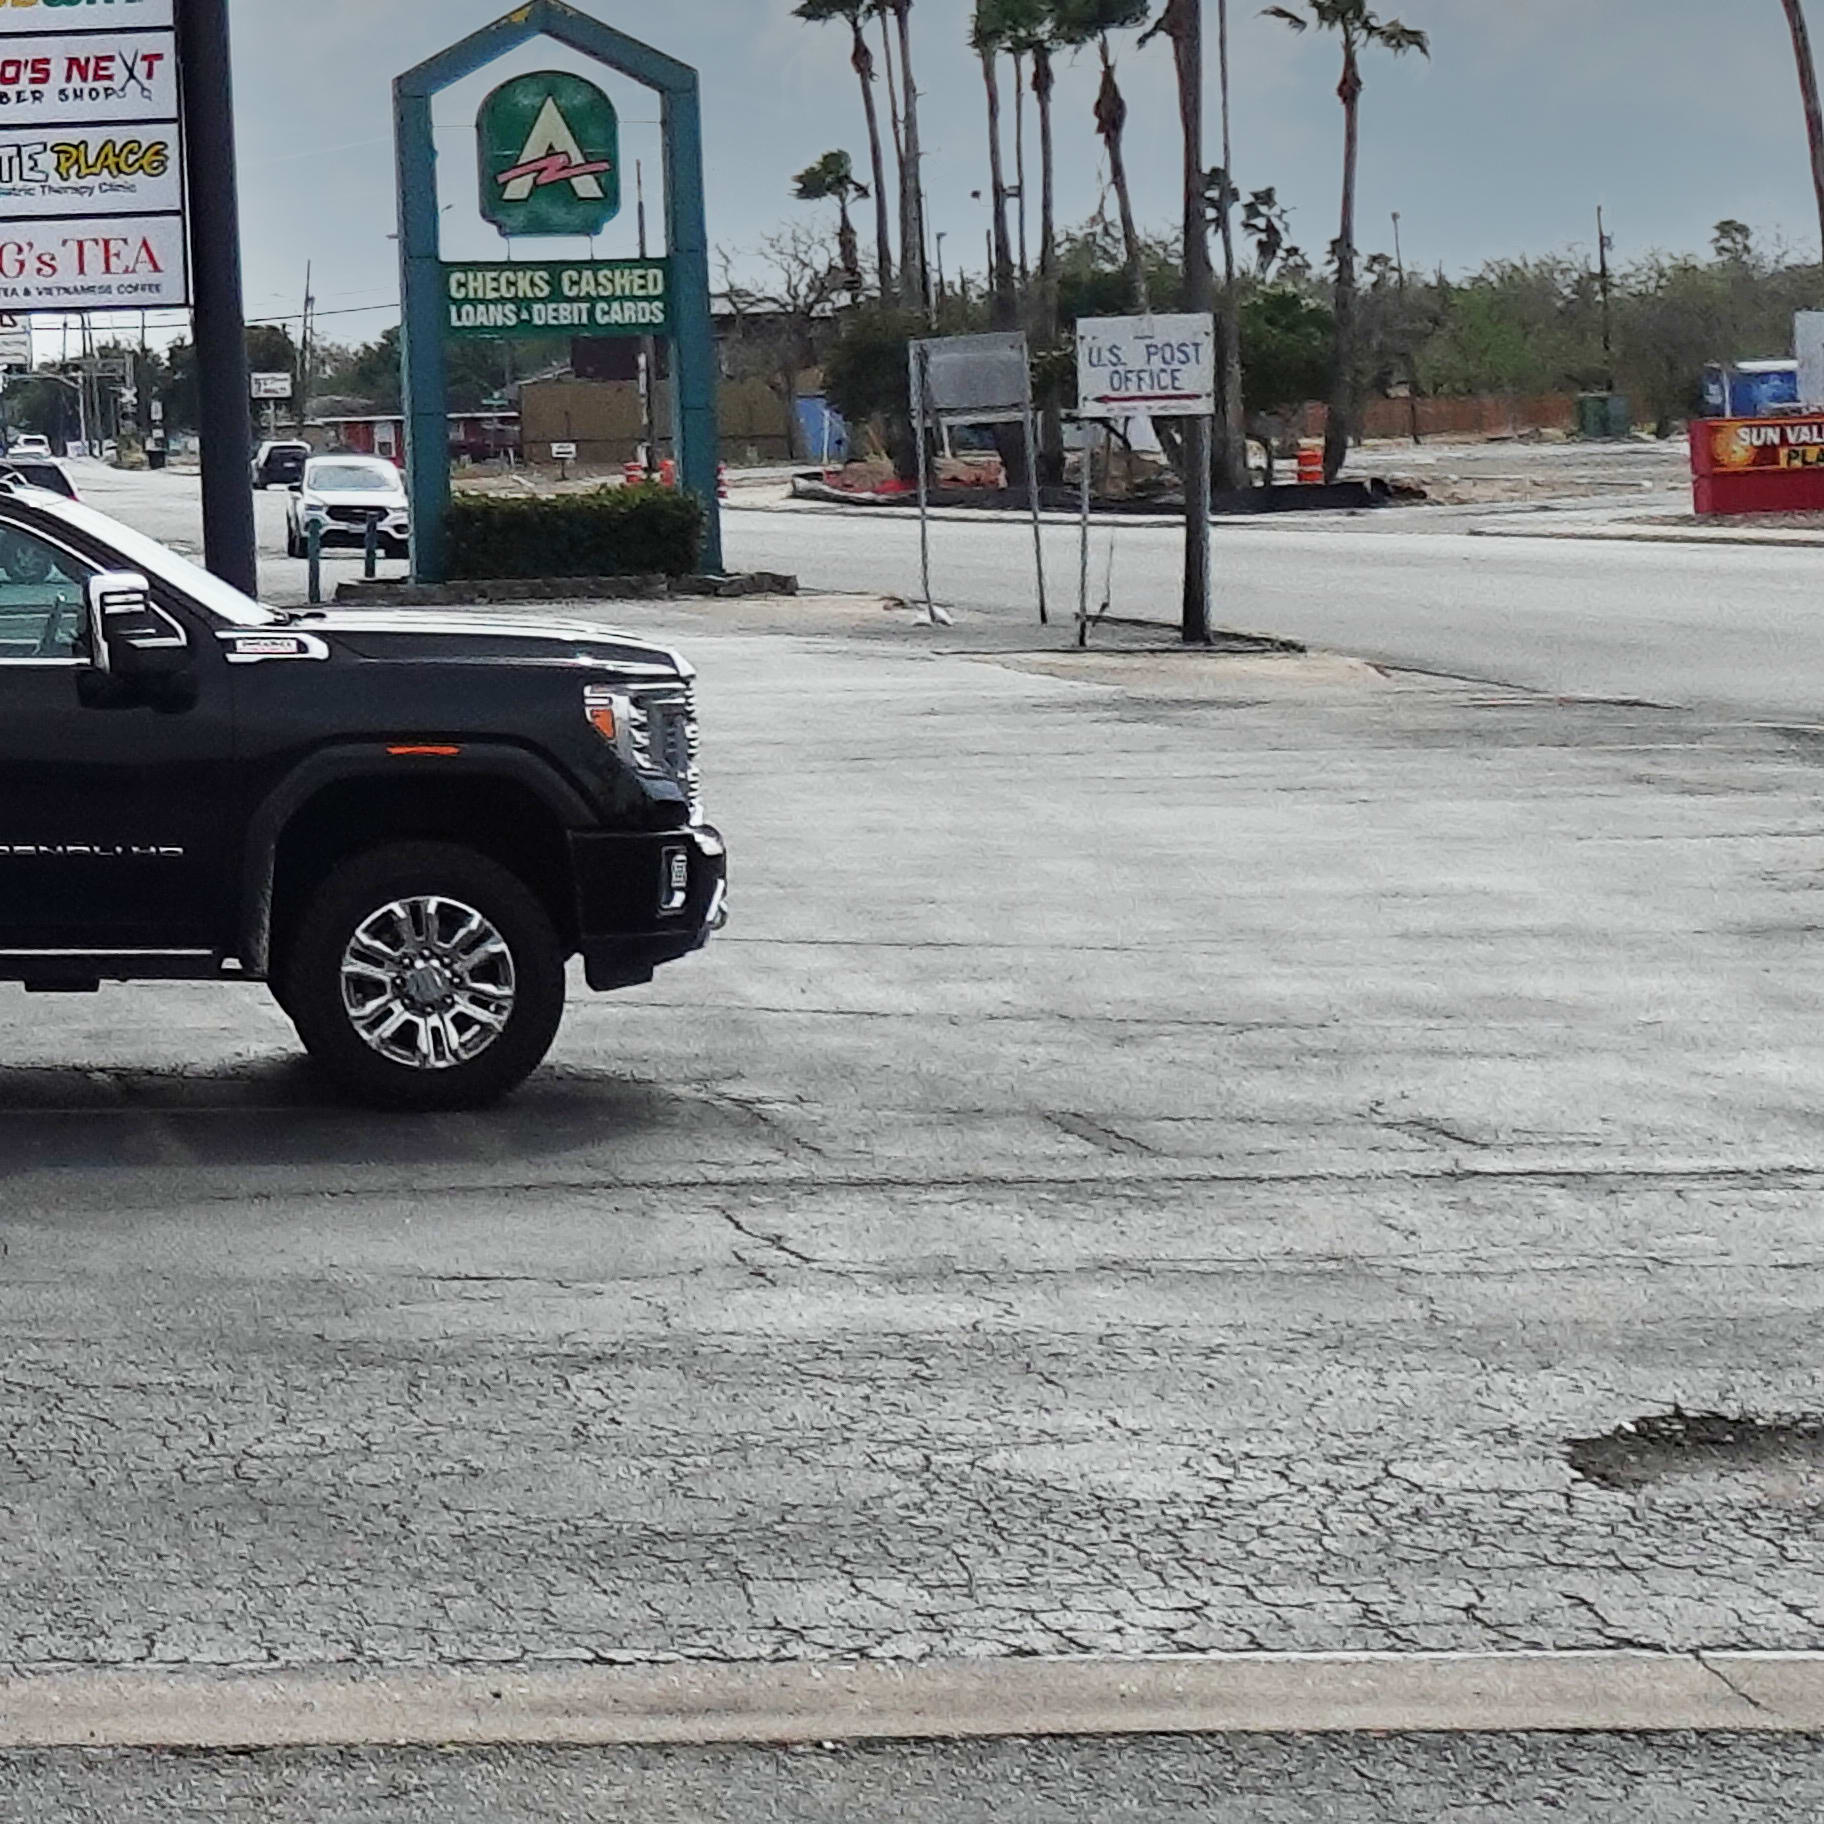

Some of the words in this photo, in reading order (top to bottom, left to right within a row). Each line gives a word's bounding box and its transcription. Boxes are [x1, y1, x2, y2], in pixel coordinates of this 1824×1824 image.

[58, 86, 117, 103] SHOP
[50, 139, 169, 180] PLACE
[61, 236, 164, 277] TEA
[448, 269, 551, 300] CHECKS
[560, 267, 665, 298] CASHED
[449, 303, 519, 327] LOANS
[531, 302, 591, 326] DEBIT
[594, 300, 665, 325] CARDS
[1145, 342, 1203, 366] POST
[1109, 367, 1184, 392] OFFICE
[1736, 425, 1781, 447] SUN
[1785, 423, 1824, 445] VAL
